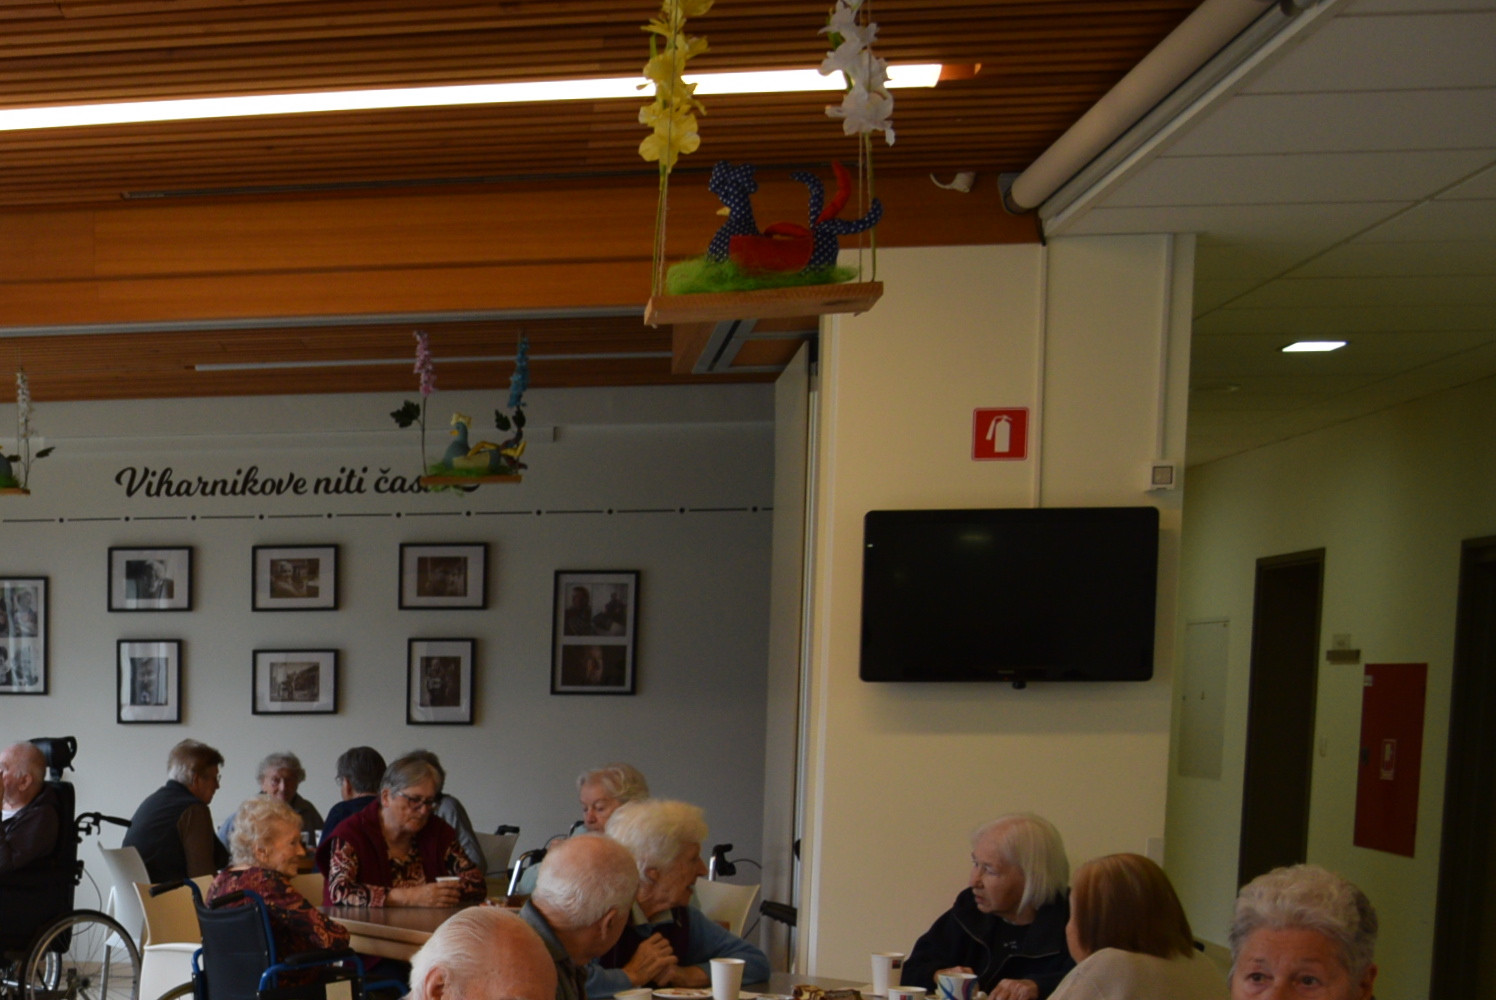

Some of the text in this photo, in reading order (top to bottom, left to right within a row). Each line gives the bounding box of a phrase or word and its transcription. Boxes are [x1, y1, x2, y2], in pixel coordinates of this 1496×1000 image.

[114, 465, 480, 498] Viharnikove niti čas
